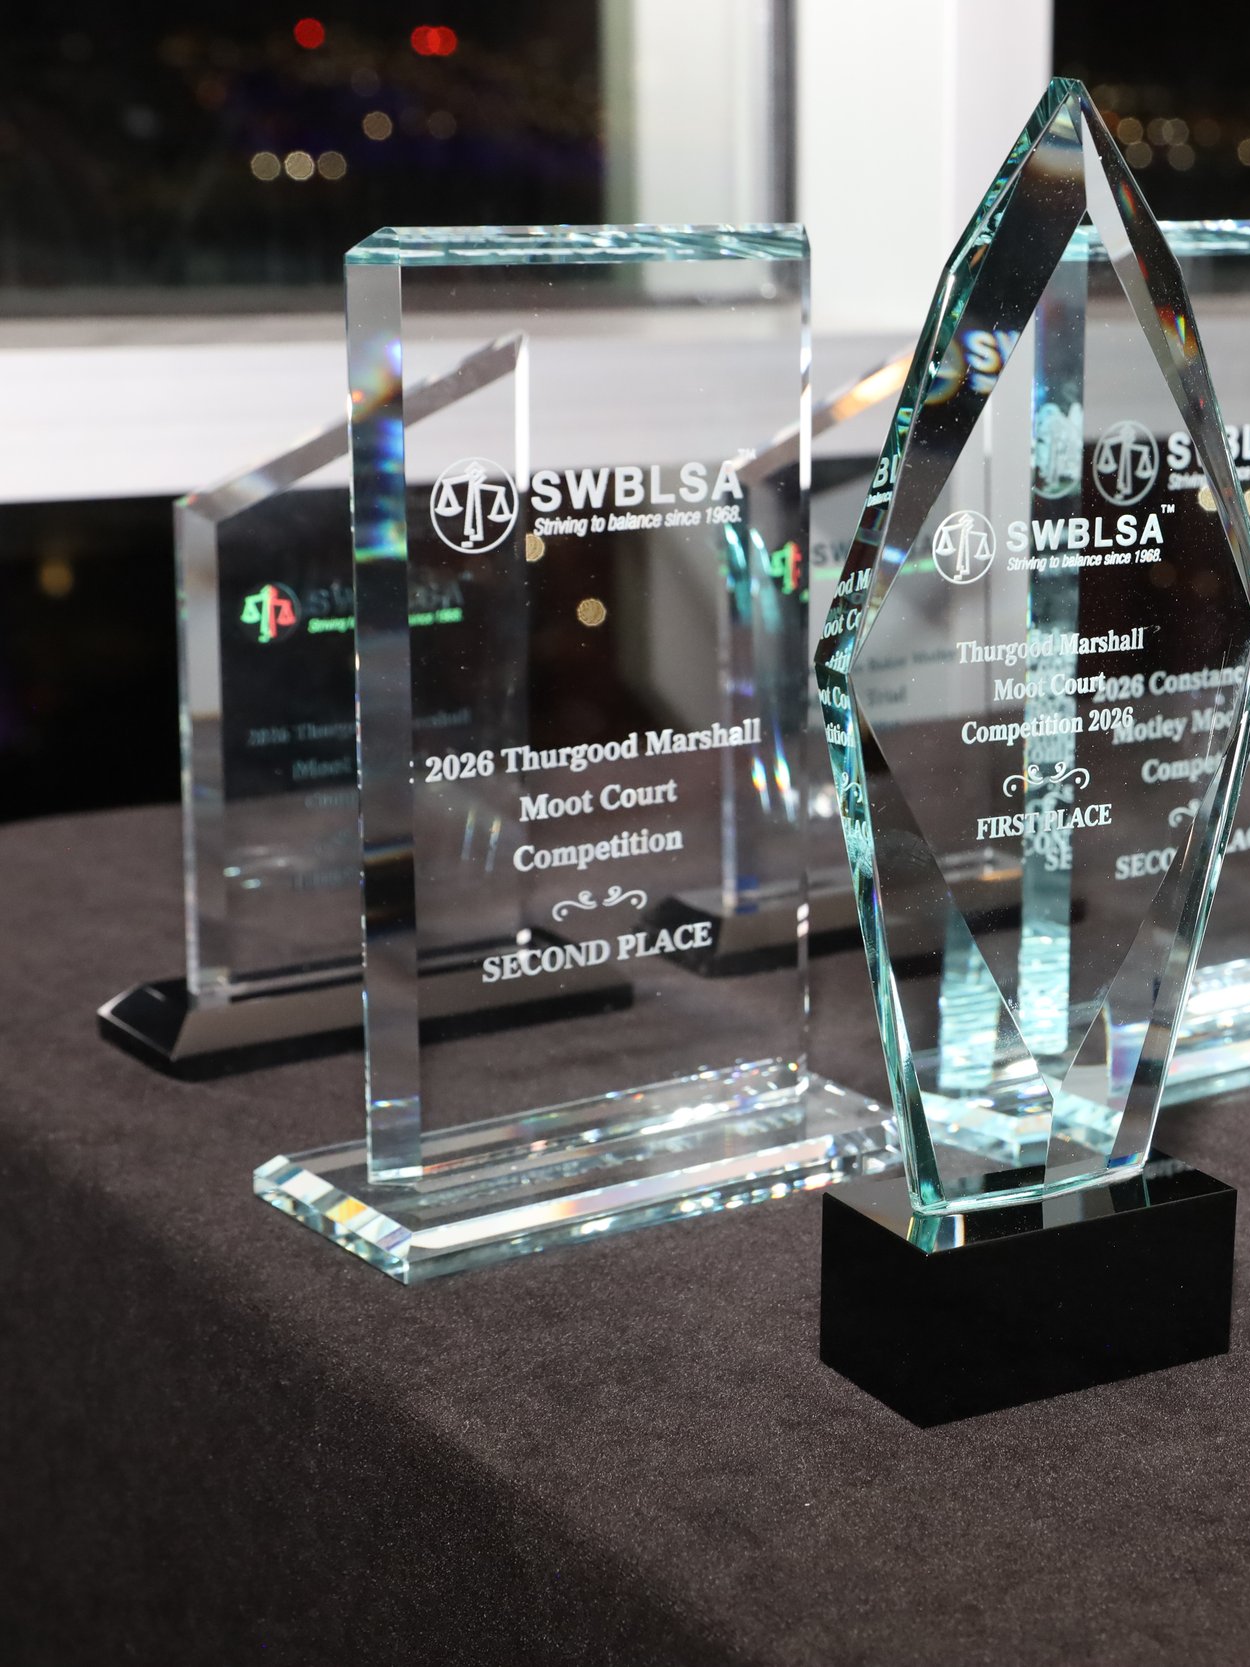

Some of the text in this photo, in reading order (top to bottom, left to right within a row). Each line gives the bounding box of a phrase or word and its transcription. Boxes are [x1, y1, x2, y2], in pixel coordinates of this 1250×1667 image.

[530, 460, 744, 513] SWBLSA
[533, 505, 742, 537] Striving to balance since 1968.
[1006, 504, 1176, 552] SWBLSA TM
[1006, 548, 1162, 572] Striving to balance since 1968.
[956, 627, 1145, 667] Thurgood Marshall
[993, 671, 1107, 701] Moot Court
[1092, 673, 1145, 703] 2026
[1149, 665, 1246, 696] Constanc
[961, 706, 1134, 746] Competition 2026
[1111, 714, 1188, 746] Motley
[425, 718, 762, 783] 2026 Thurgood Marshall
[519, 779, 678, 822] Moot Court
[976, 804, 1112, 840] FIRST PLACE
[513, 828, 684, 871] Competition
[1115, 848, 1179, 881] SECO
[482, 921, 713, 983] SECOND PLACE
